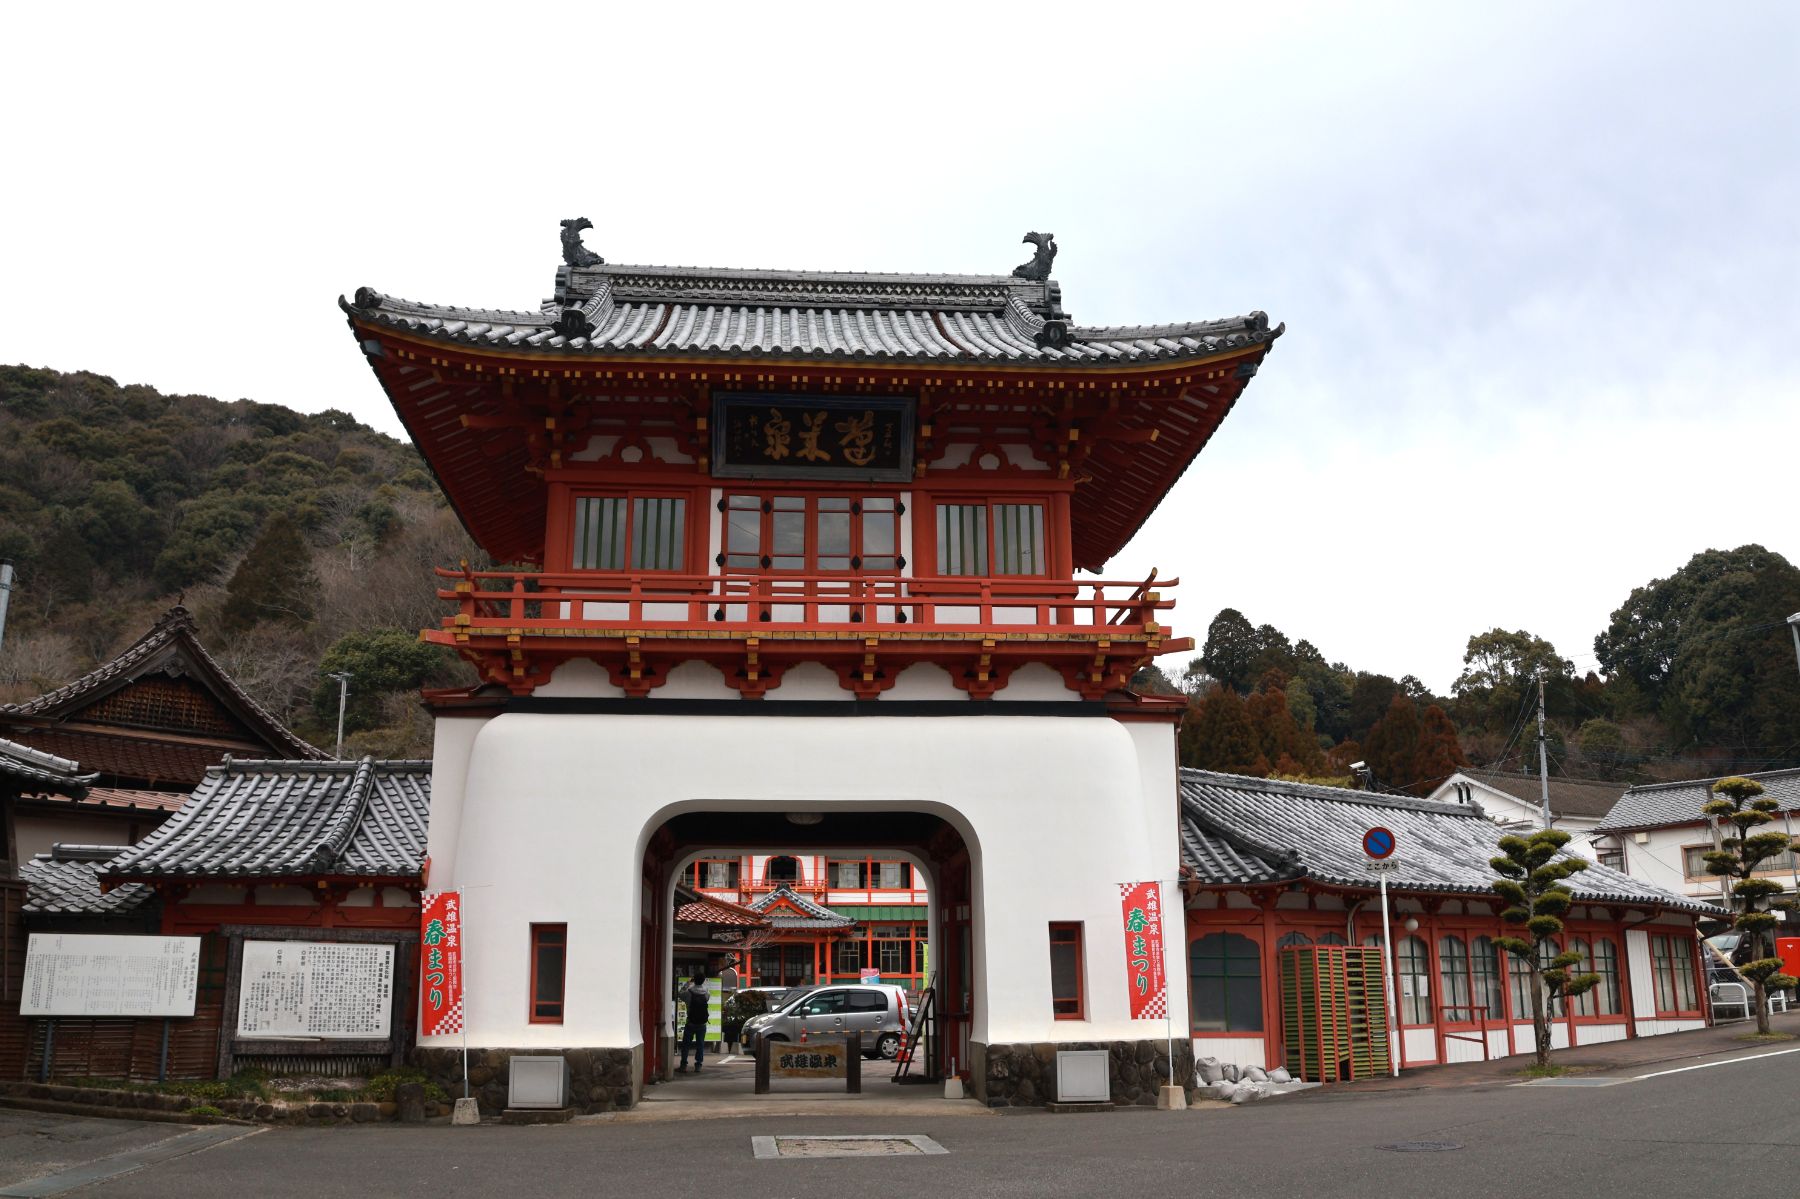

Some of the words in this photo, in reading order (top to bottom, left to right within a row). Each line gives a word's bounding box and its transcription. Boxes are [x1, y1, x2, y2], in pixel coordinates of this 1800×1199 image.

[1366, 861, 1397, 871] ここから
[444, 898, 458, 948] 武雄温泉
[1145, 888, 1159, 935] 武雄温泉
[423, 918, 448, 1011] 春まつり
[1126, 907, 1150, 996] 春まつり
[780, 1053, 838, 1068] 武雄温泉
